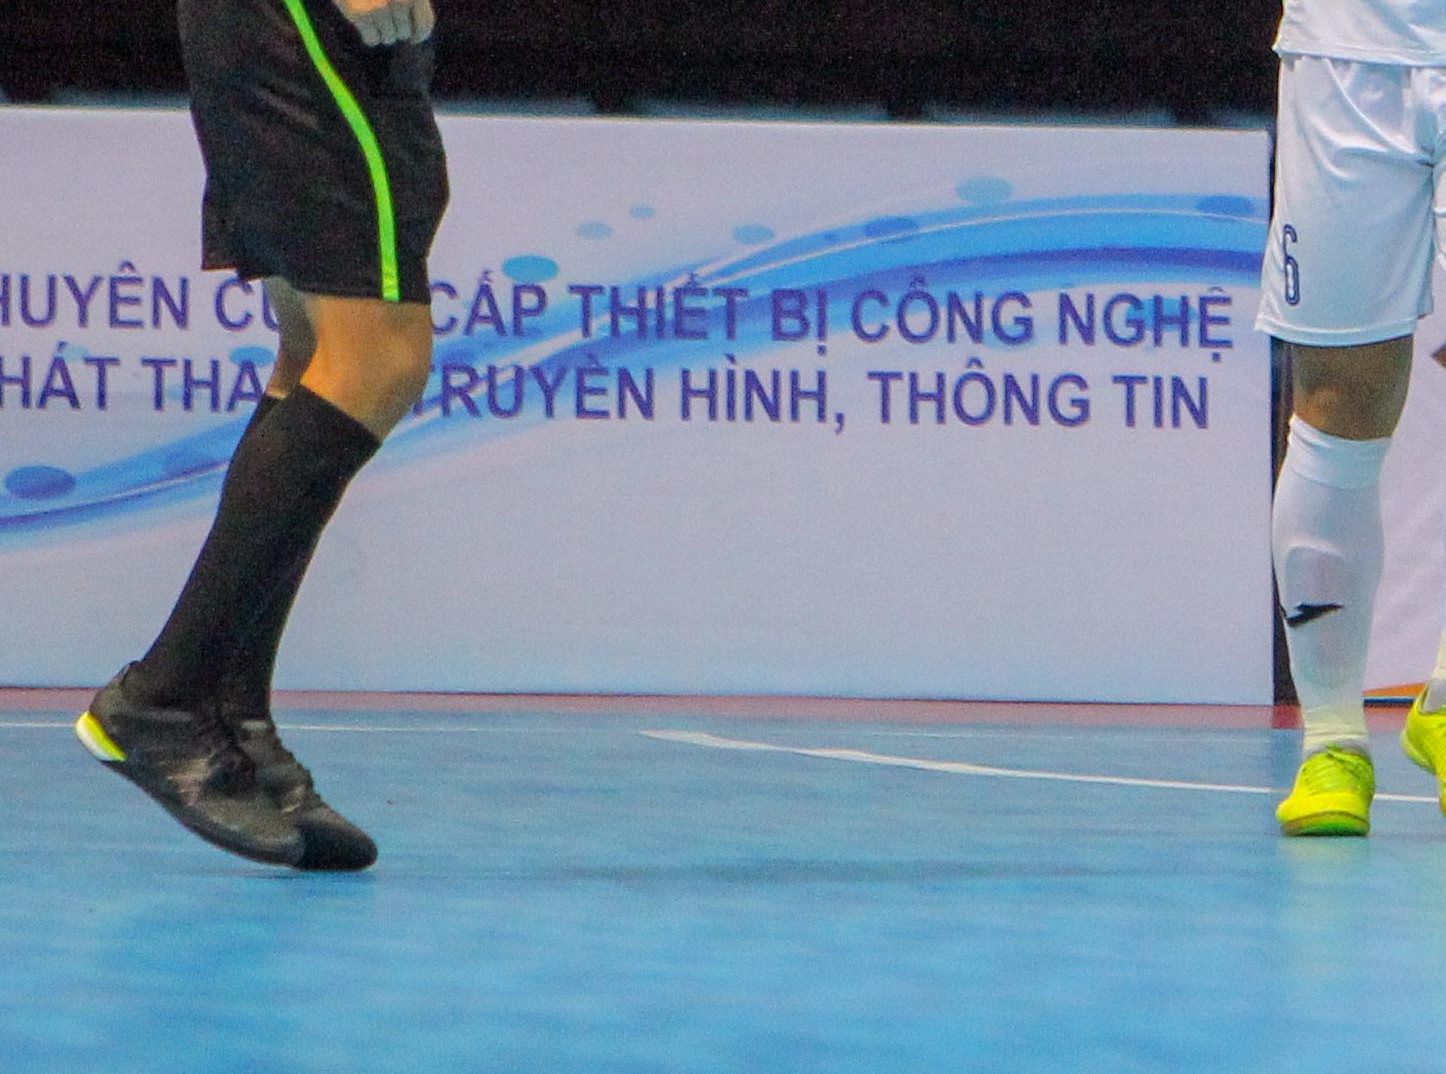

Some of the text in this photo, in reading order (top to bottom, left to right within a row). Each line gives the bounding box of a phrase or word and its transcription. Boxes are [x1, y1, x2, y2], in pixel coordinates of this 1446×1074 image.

[1282, 223, 1300, 307] 6
[569, 273, 748, 341] THIẾT
[771, 286, 828, 356] BỊ
[851, 276, 1034, 345] CÔNG
[1058, 286, 1234, 363] NGHỆ
[412, 352, 655, 420] RUYỀN
[680, 353, 847, 435] HÌNH,
[866, 357, 1090, 428] THÔNG
[1112, 374, 1208, 429] TIN
